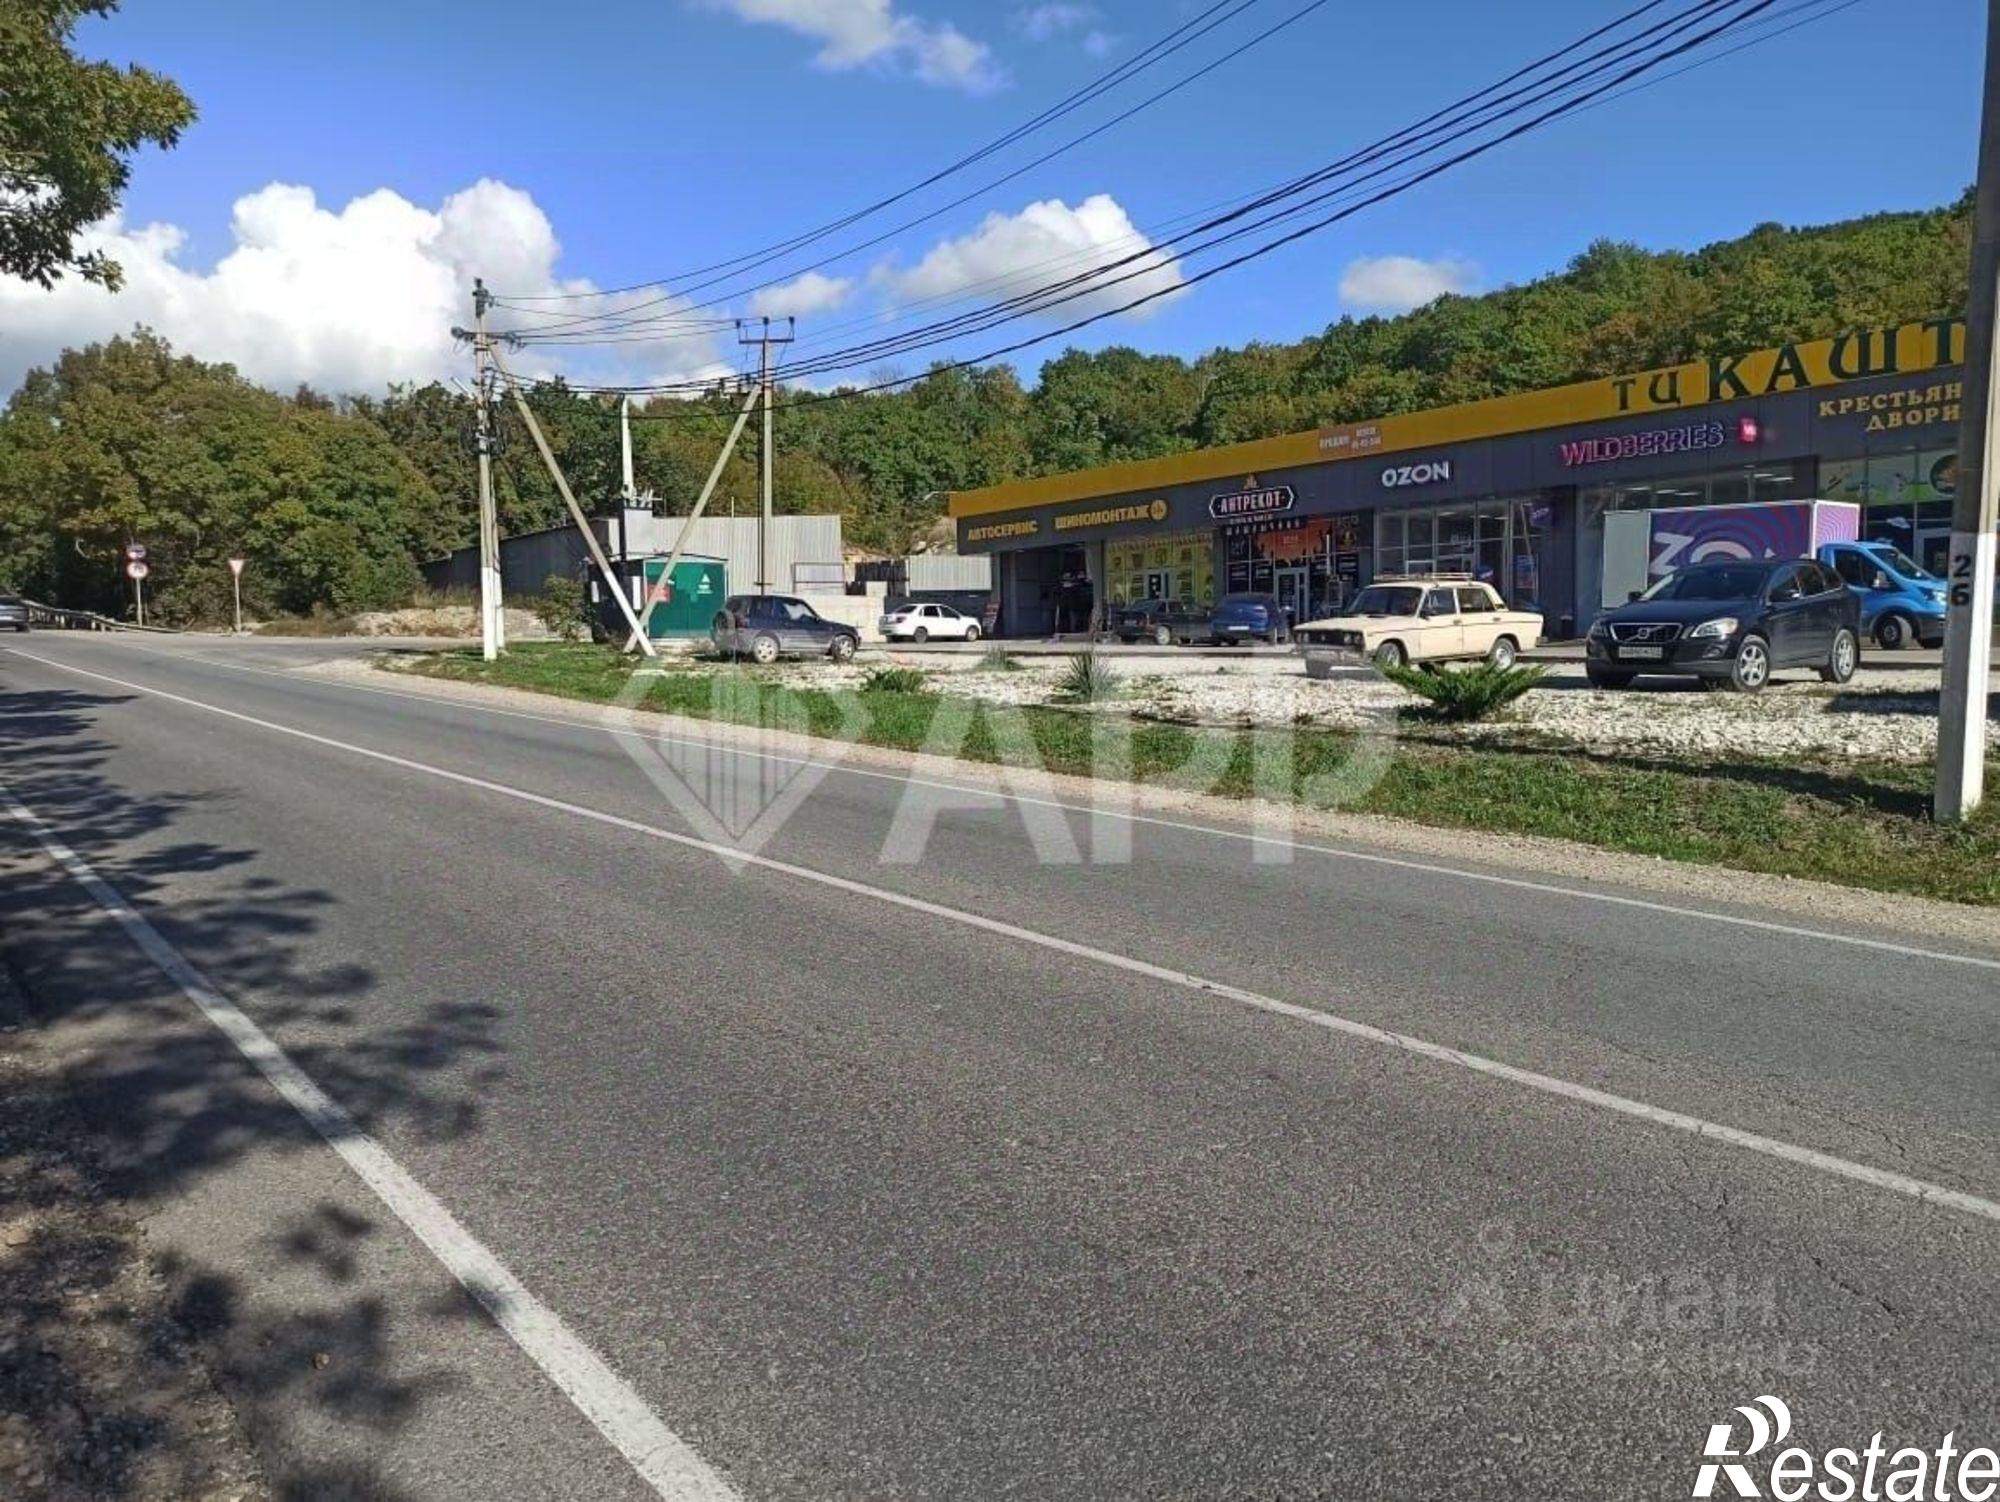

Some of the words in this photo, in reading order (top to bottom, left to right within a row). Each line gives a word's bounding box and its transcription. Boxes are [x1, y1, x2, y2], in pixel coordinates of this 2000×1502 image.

[1612, 370, 1682, 411] ТЦ
[1818, 381, 1963, 417] КРЕСТЬЯН
[1561, 422, 1726, 466] WILDBERRIES
[1381, 461, 1450, 488] OZON
[1220, 490, 1282, 515] АНТРЕКОТ
[967, 519, 1039, 542] АВТОСЕРВИС
[1054, 503, 1151, 531] ШИНОМОНТАЖ
